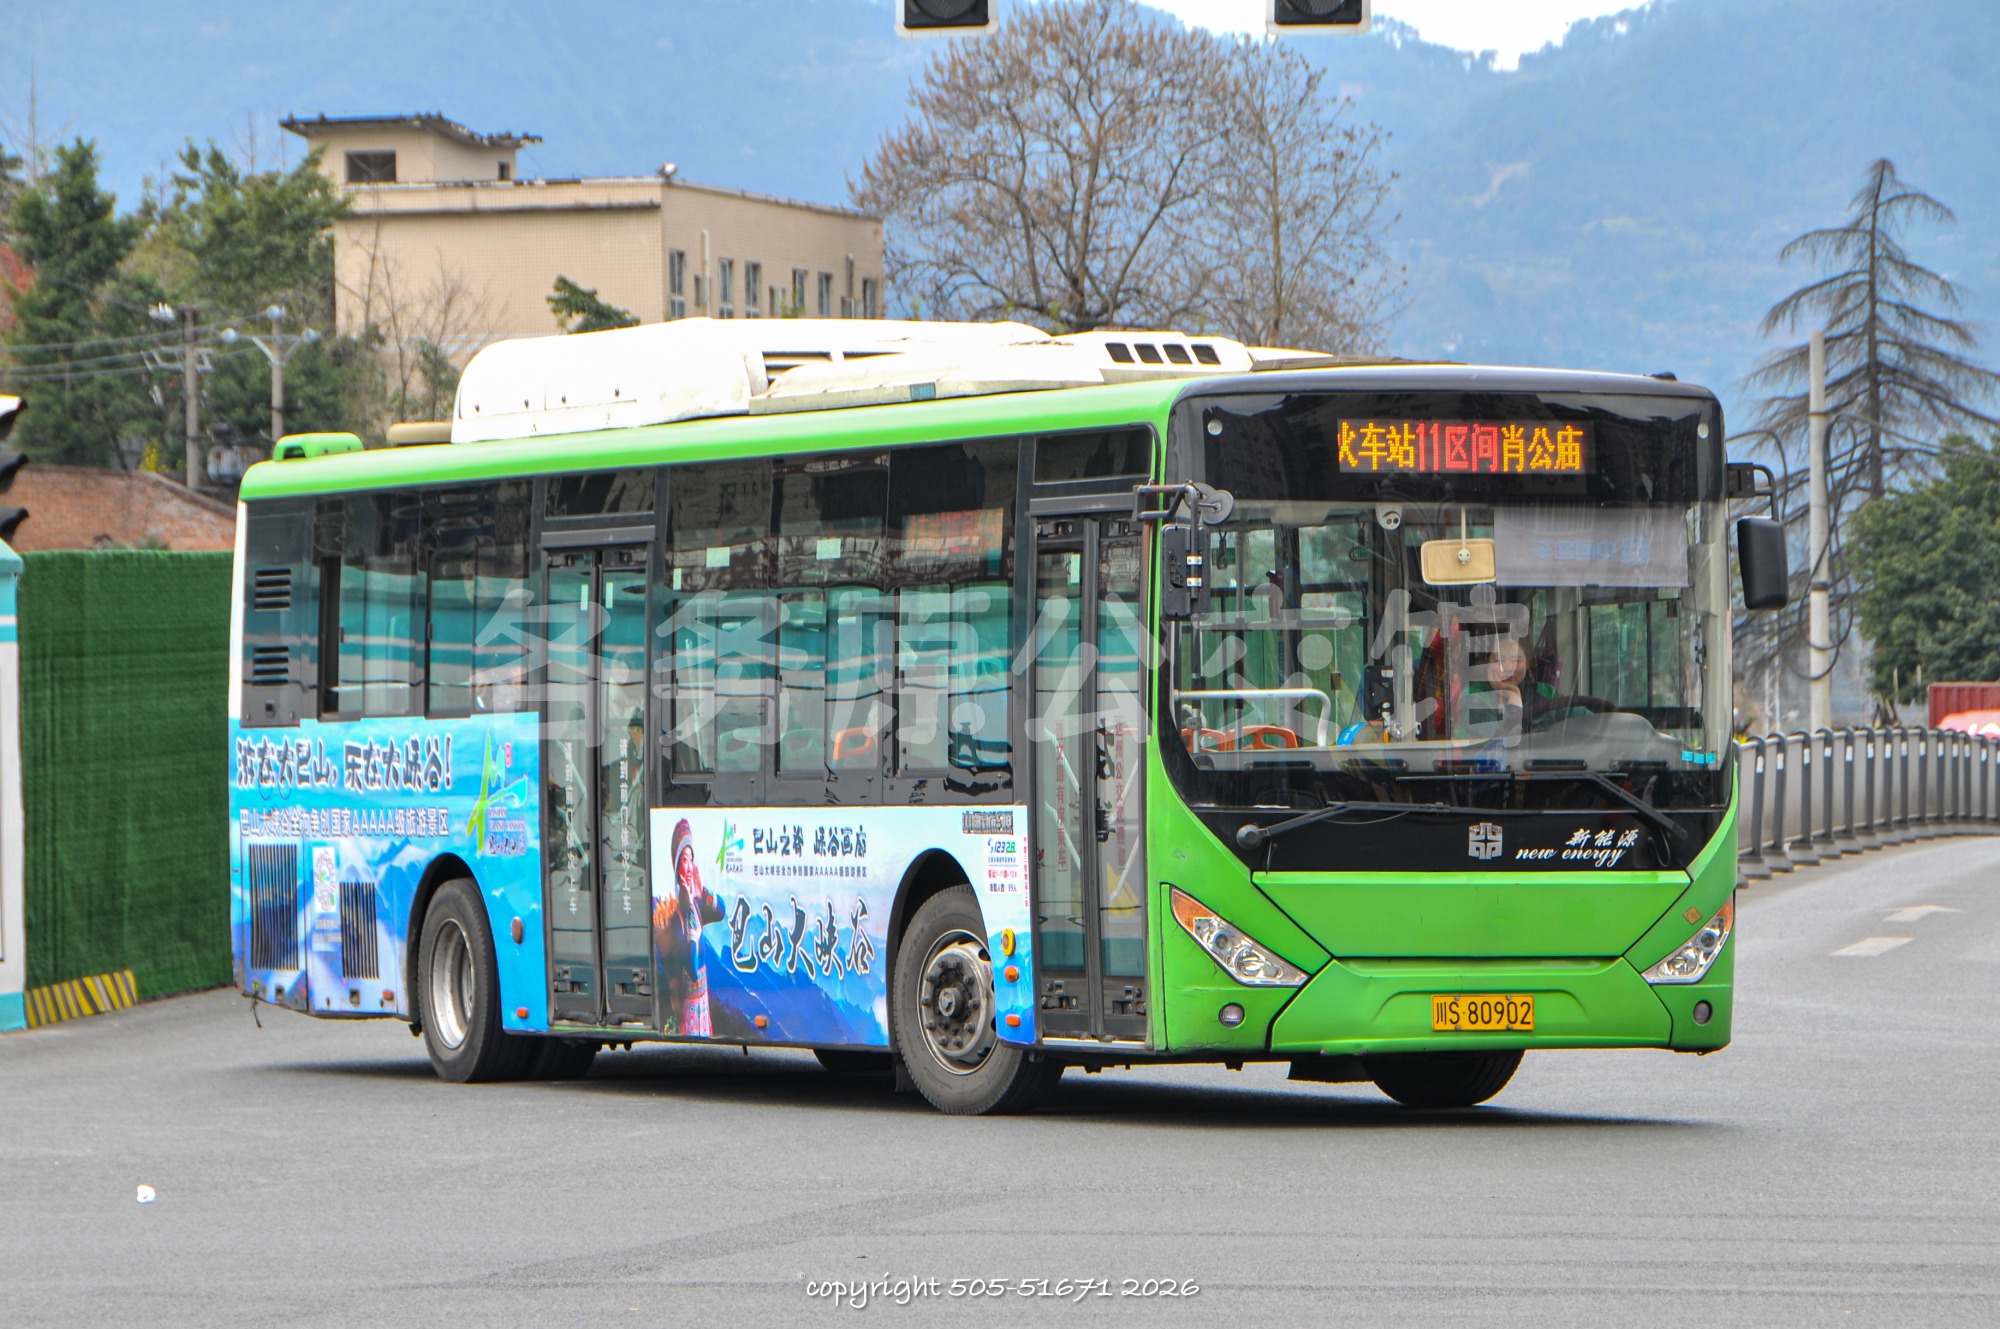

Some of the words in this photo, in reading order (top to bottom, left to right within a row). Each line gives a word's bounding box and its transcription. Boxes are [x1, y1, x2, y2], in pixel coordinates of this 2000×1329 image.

[1338, 422, 1583, 472] 火车站11区间肖公庙
[239, 807, 449, 838] 巴山大峡谷全力争创国家AAAAA级旅游景区
[753, 824, 804, 857] 巴山之脊
[813, 824, 867, 858] 峡谷画廊
[994, 841, 1016, 853] 12328
[1566, 828, 1639, 847] 新能源
[1515, 847, 1557, 860] new
[1562, 847, 1626, 867] energy
[753, 865, 867, 877] 巴山大峡谷全力争创国家AAAAA级旅游景区
[728, 894, 876, 980] 巴山大峡谷
